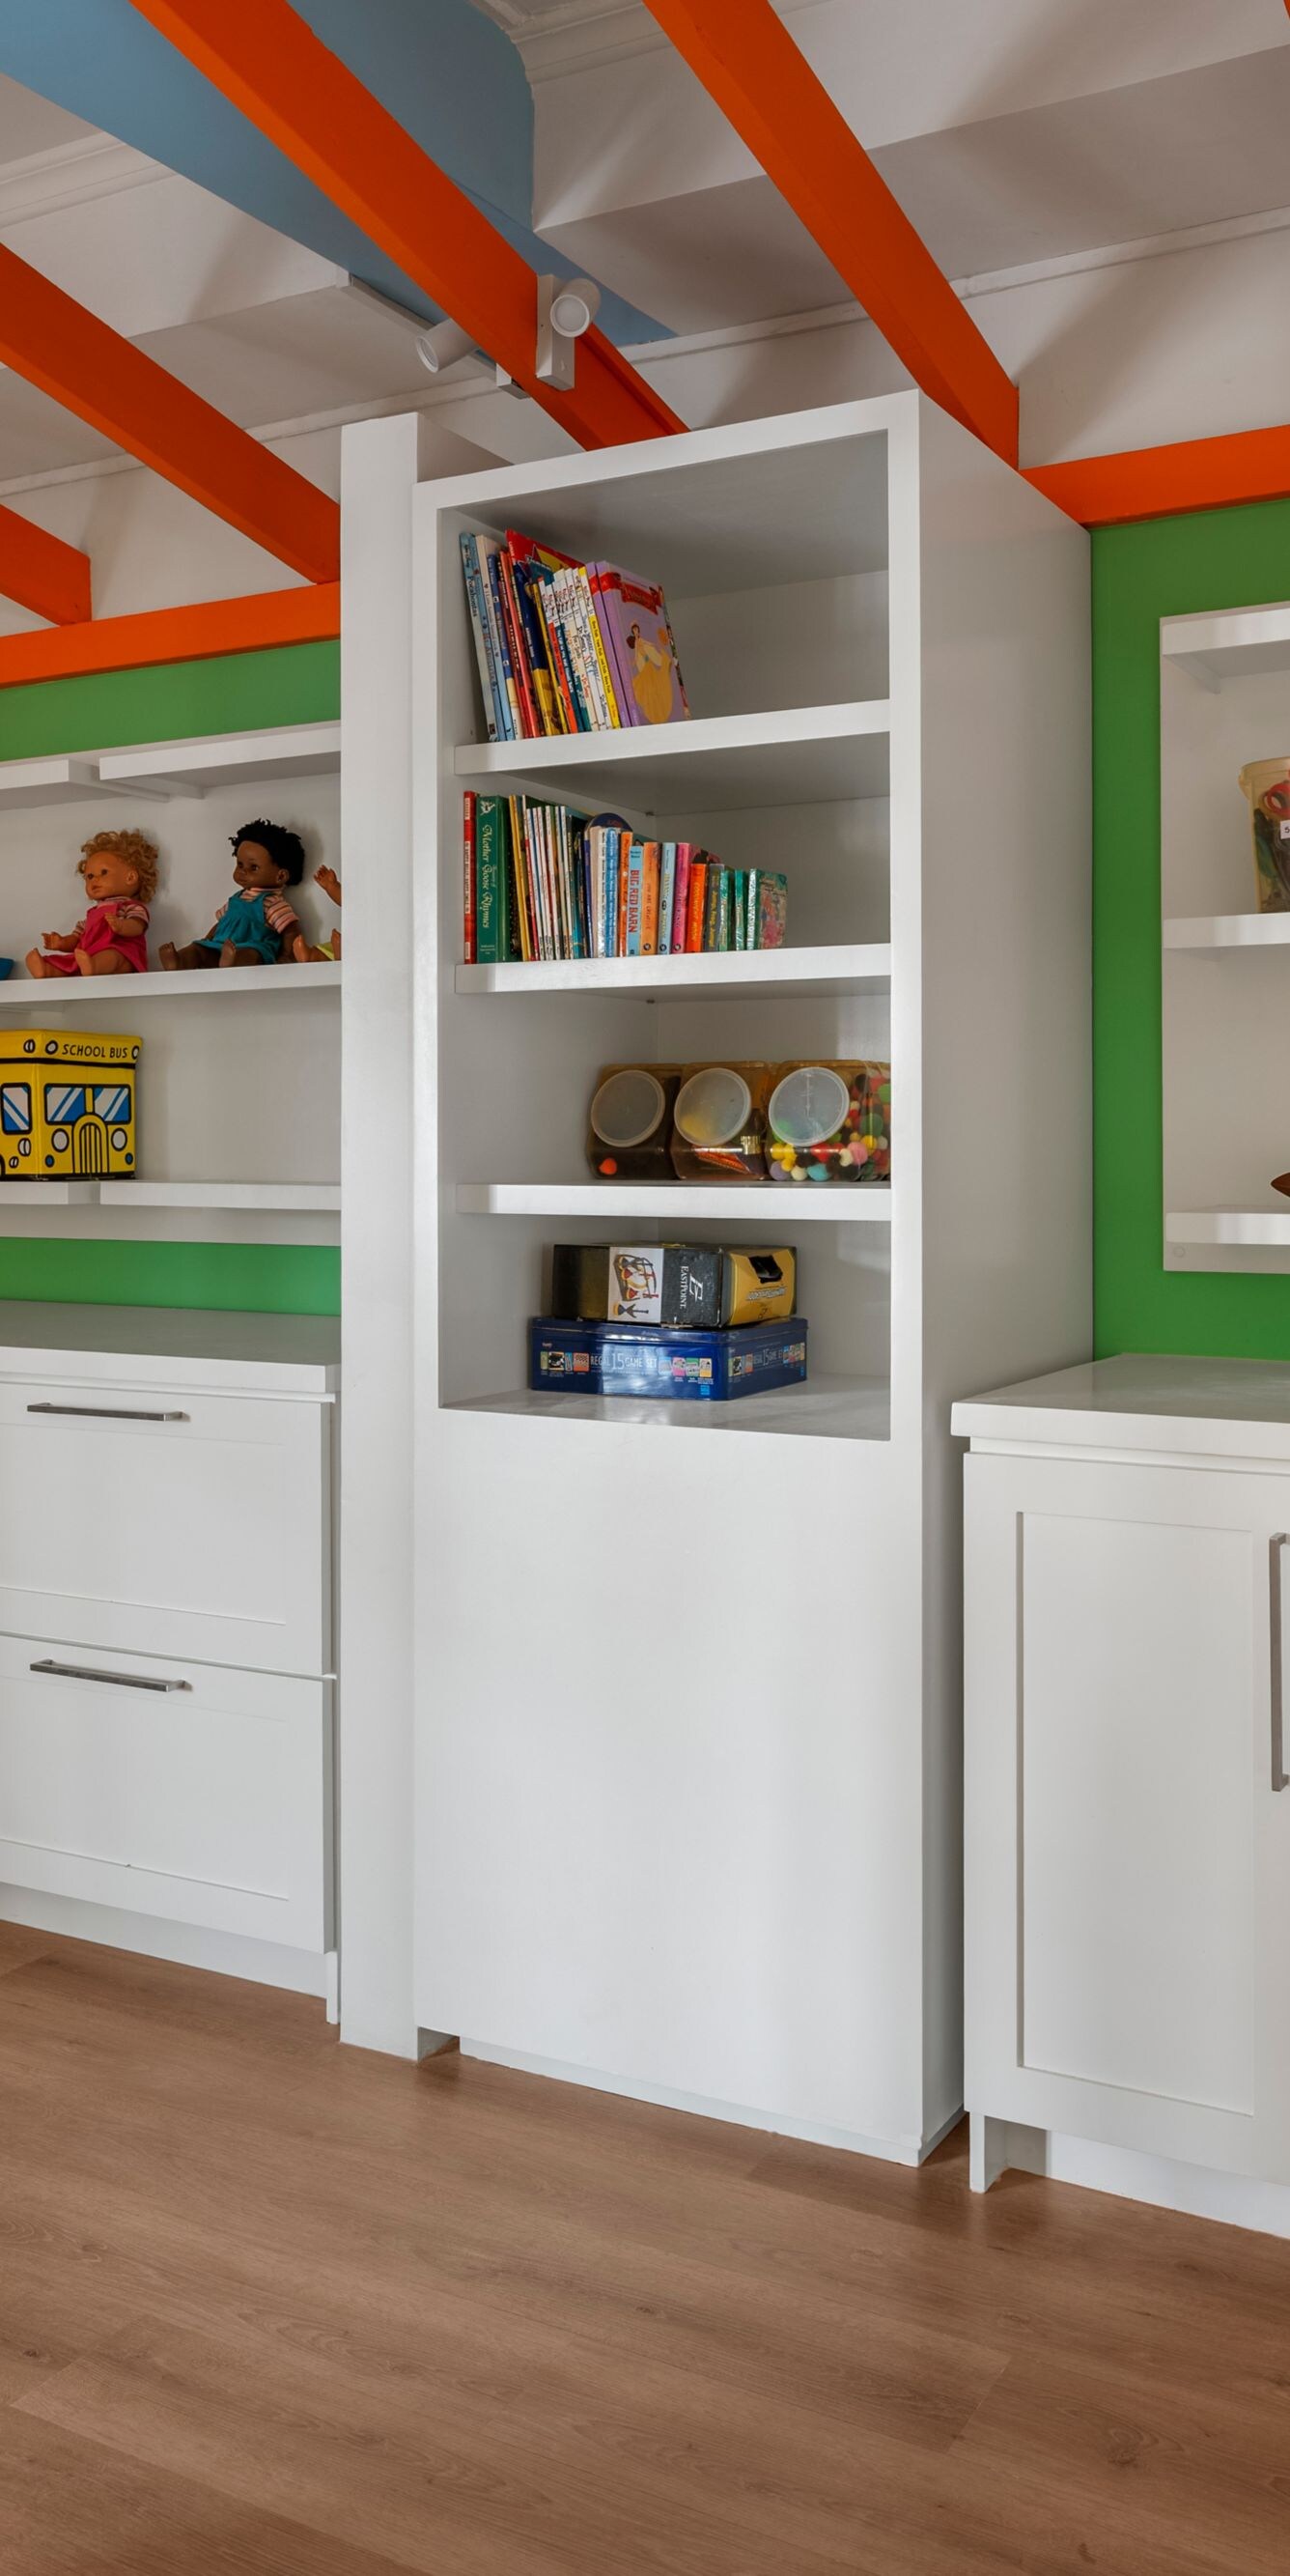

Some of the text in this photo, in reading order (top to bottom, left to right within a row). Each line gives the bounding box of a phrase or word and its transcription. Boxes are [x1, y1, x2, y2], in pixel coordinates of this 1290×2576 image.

[467, 576, 479, 617] Pocahontas
[479, 824, 492, 927] Mother Goose Rhymes
[630, 869, 639, 885] BIG
[629, 888, 638, 904] RED
[628, 906, 637, 932] BARN
[62, 1043, 128, 1059] SCHOOL BUS
[679, 1265, 689, 1309] EASTPOINT
[590, 1352, 658, 1370] REGAL 15 GAME SET
